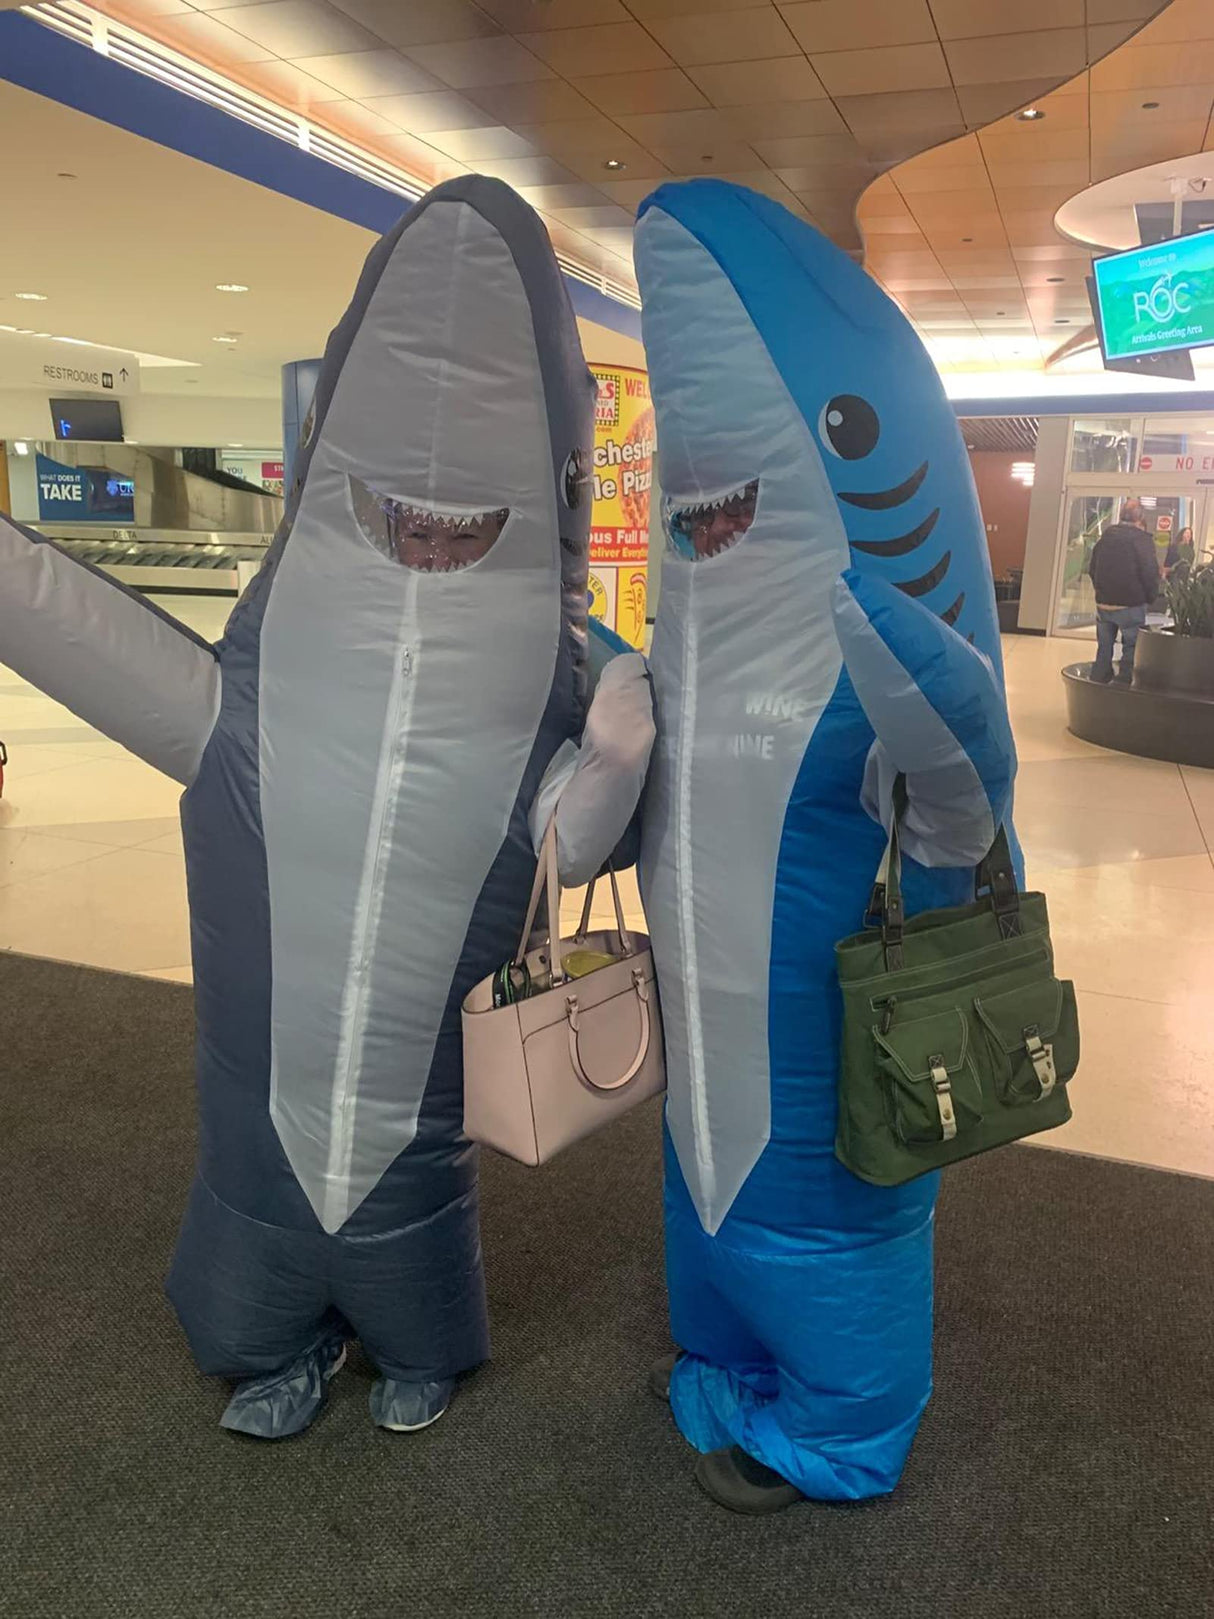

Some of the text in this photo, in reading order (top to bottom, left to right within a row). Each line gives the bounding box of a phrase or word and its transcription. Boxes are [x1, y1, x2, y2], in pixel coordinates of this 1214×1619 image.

[1132, 275, 1192, 323] ROC
[1131, 325, 1203, 344] Arrivals Greeting Area
[43, 364, 99, 385] RESTROOMS
[1175, 456, 1194, 471] NO
[40, 474, 57, 482] WHAT
[58, 474, 74, 482] DOES
[40, 483, 82, 501] TAKE
[113, 530, 137, 540] DELTA
[616, 529, 638, 544] Full
